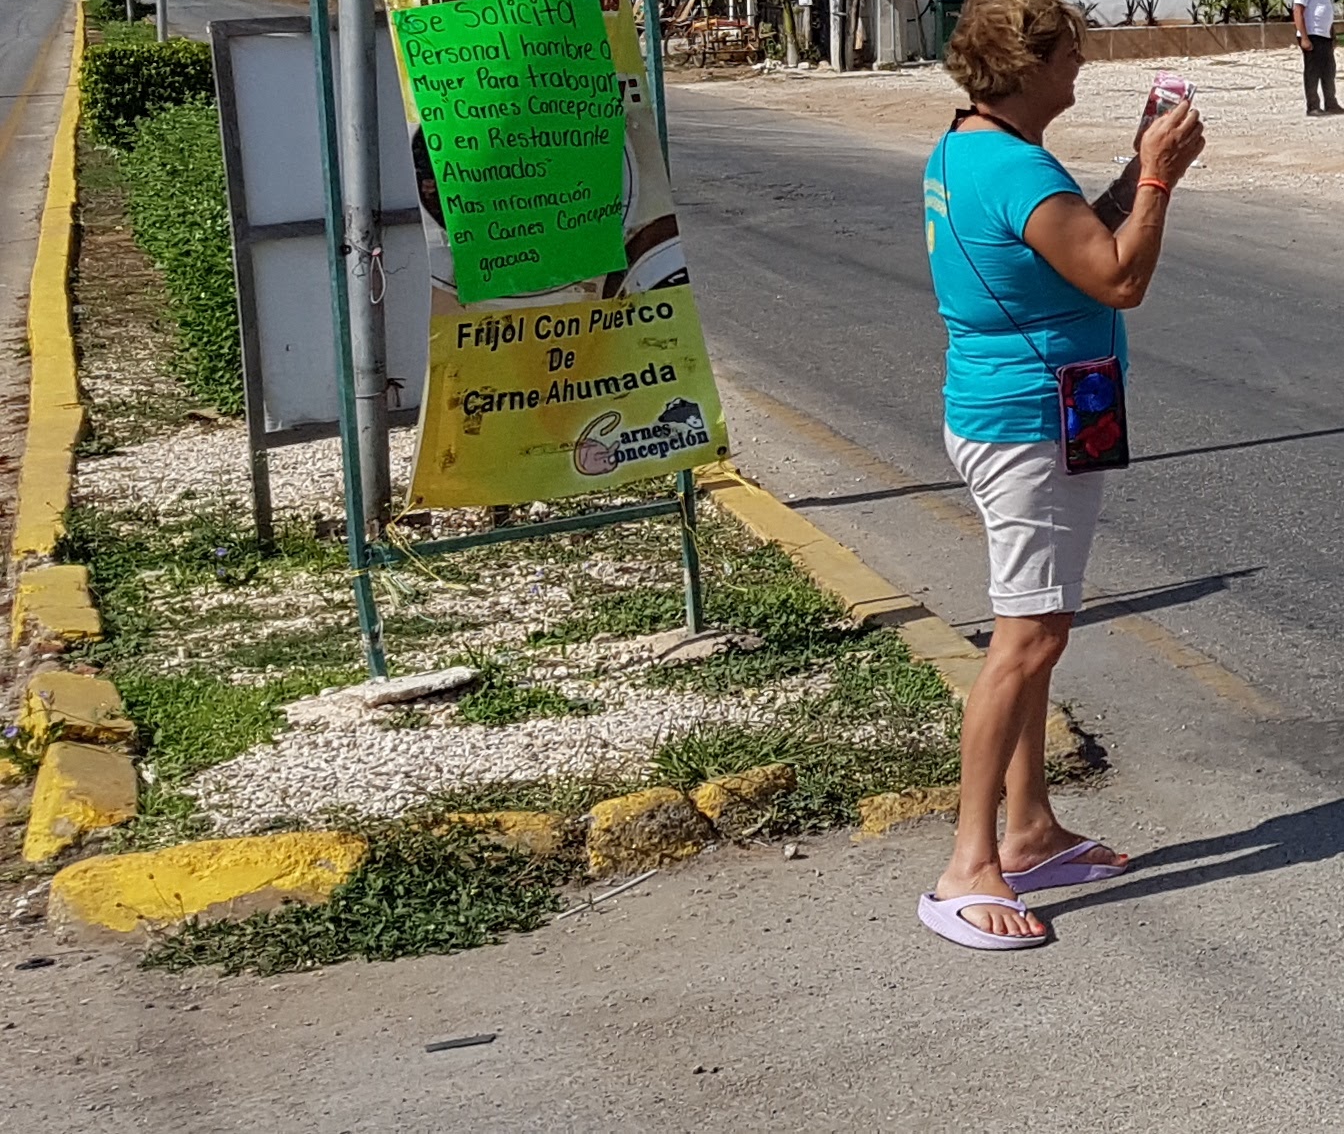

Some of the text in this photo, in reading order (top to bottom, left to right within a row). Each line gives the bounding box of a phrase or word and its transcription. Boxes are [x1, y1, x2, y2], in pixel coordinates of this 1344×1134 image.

[404, 13, 445, 35] Se
[406, 31, 511, 66] Personal
[520, 34, 593, 58] hombre
[413, 76, 465, 97] Mujer
[477, 67, 519, 89] Para
[527, 64, 616, 97] trabajar
[421, 106, 445, 122] en
[455, 134, 479, 151] en
[488, 127, 610, 149] Restaurante
[454, 230, 474, 245] en
[487, 221, 545, 241] Carnes
[479, 248, 540, 282] gracias
[457, 302, 674, 351] Frijol Con Puerco
[546, 347, 575, 373] De
[463, 362, 677, 416] Carne Ahumada
